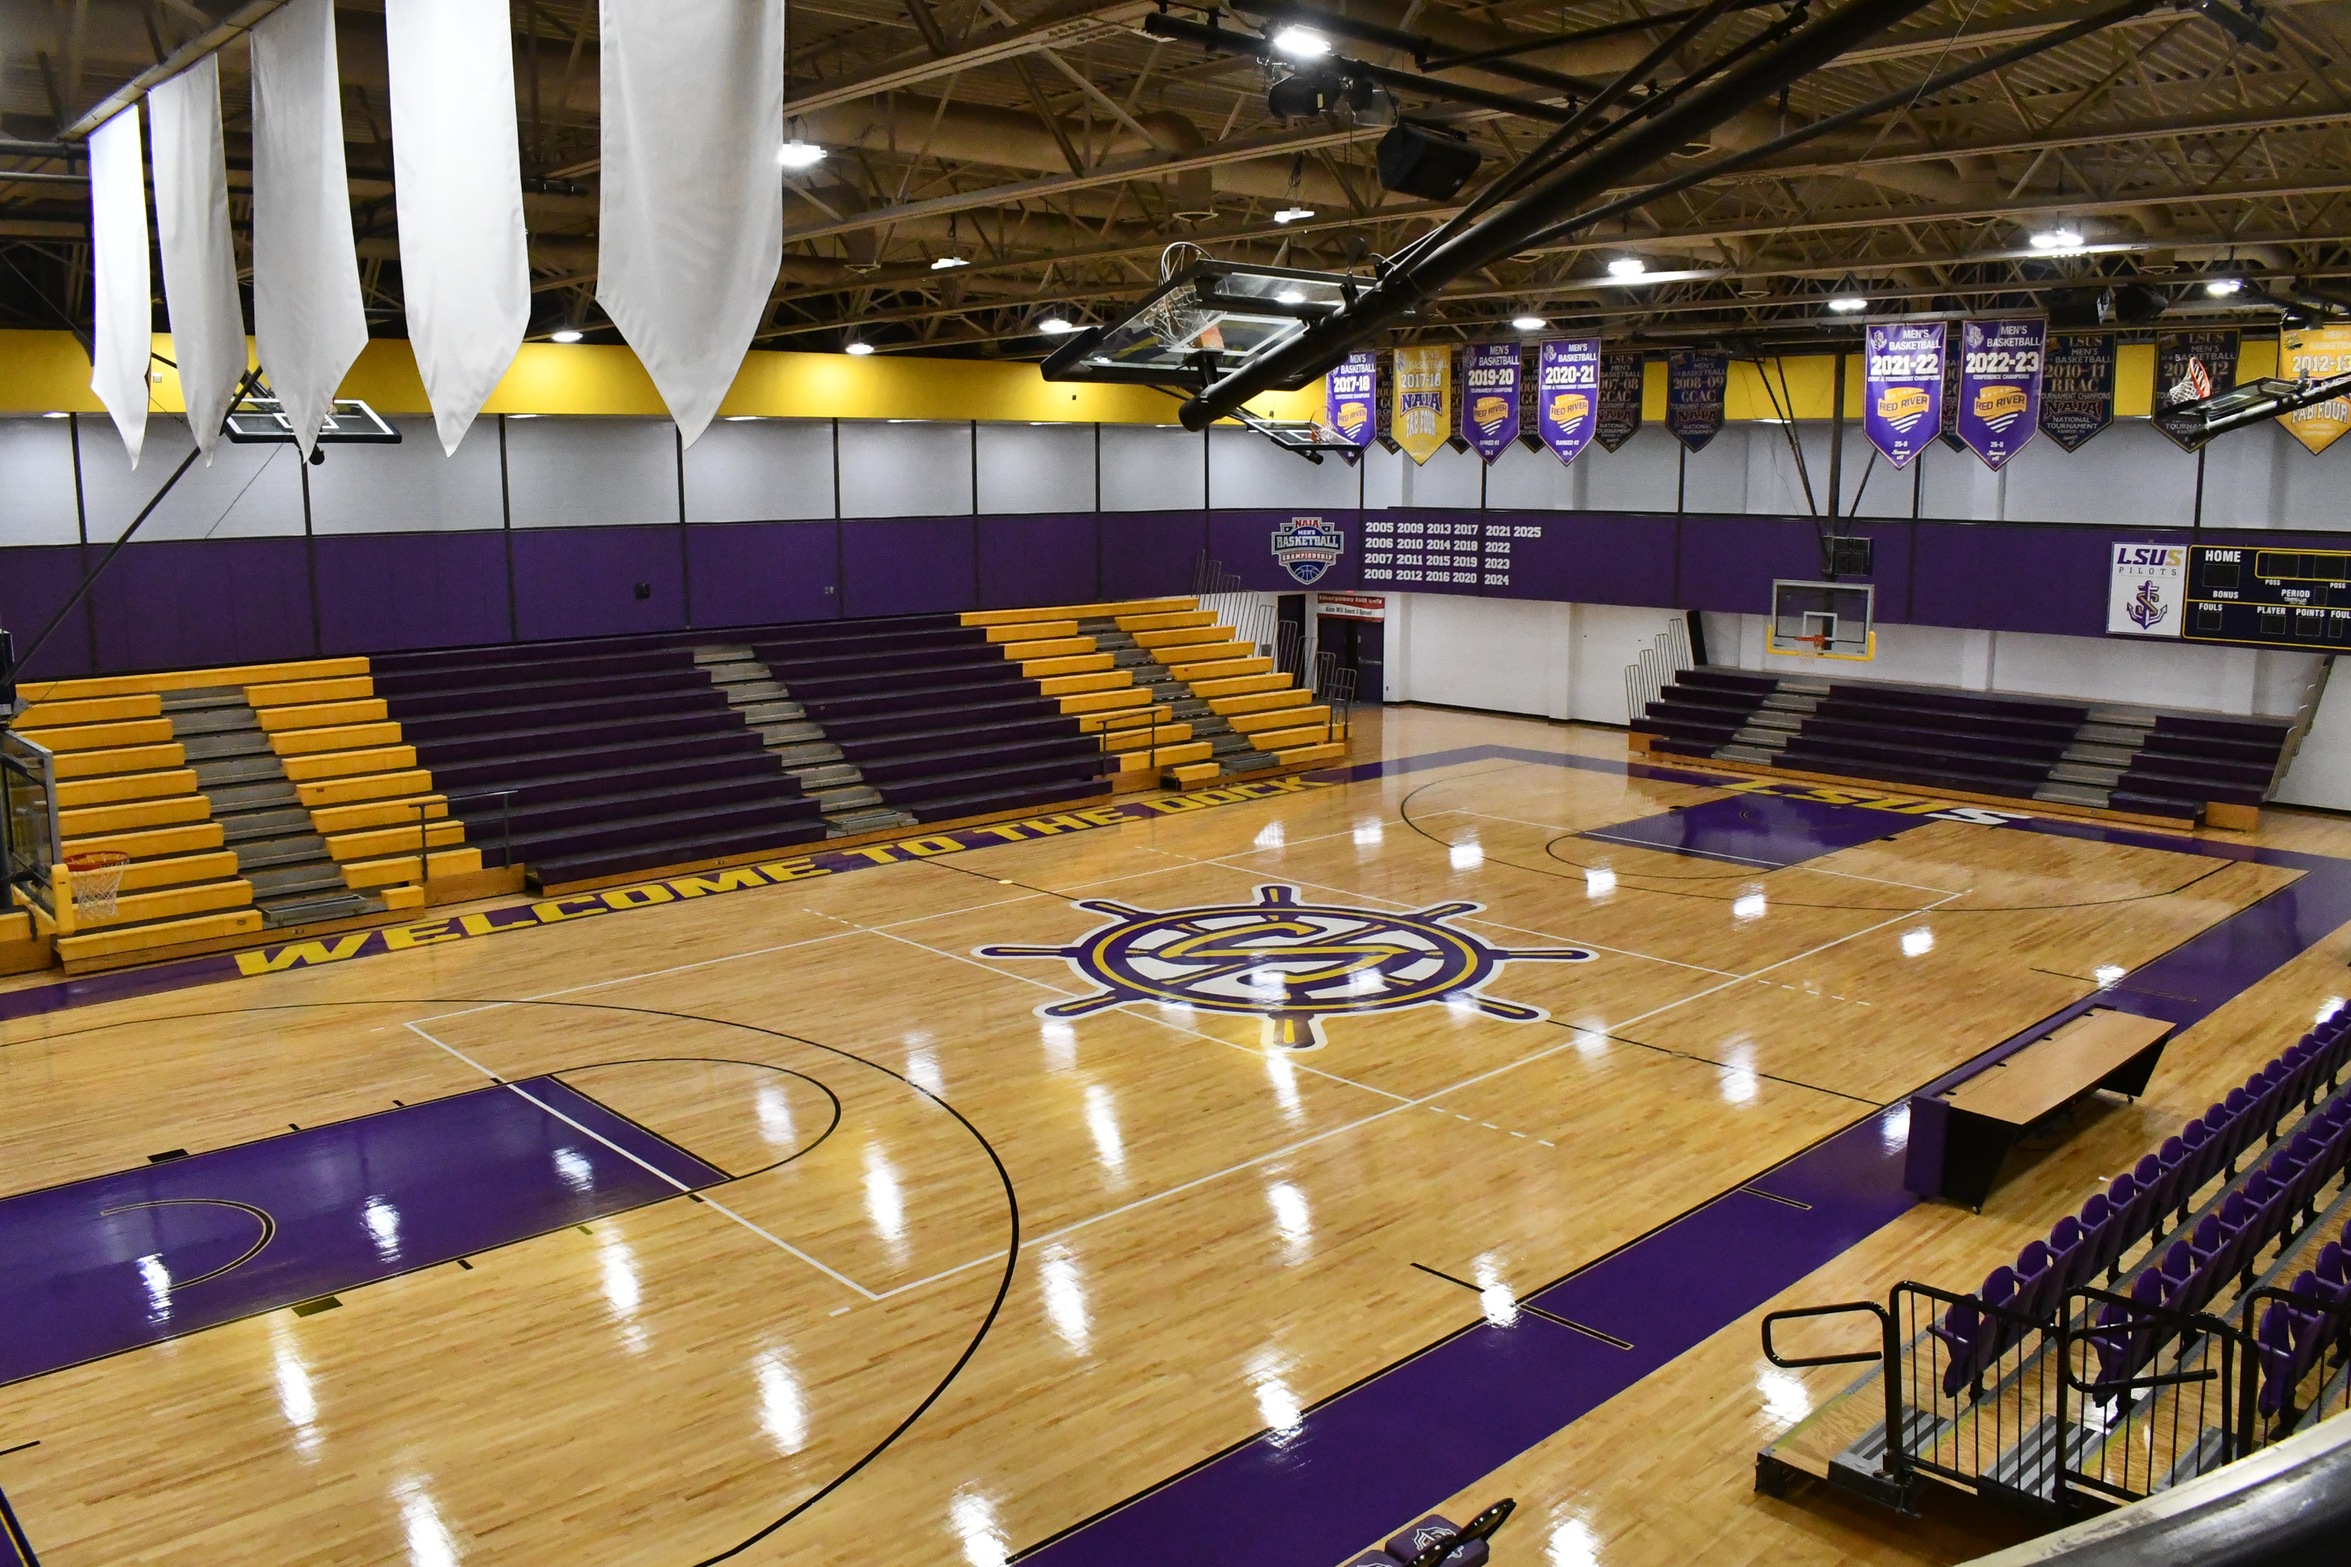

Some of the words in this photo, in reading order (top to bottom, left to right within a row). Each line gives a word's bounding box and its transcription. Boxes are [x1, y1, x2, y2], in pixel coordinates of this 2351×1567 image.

[1902, 329, 1930, 338] MEN'S
[2000, 326, 2028, 336] MEN'S
[1986, 337, 2041, 348] BASKETBALL
[2070, 336, 2102, 347] LSUS
[2189, 333, 2224, 344] LSUS
[1490, 345, 1509, 355] MEN'S
[1568, 344, 1588, 352] MEN'S
[1889, 340, 1941, 350] BASKETBALL
[2190, 345, 2220, 353] MEN'S
[1558, 352, 1597, 362] BASKETBALL
[2072, 348, 2098, 356] MEN'S
[2174, 352, 2236, 362] BASKETBALL
[1350, 354, 1366, 363] MEN'S
[1479, 355, 1519, 366] BASKETBALL
[1965, 351, 2039, 374] 2022-23
[2055, 356, 2112, 364] BASKETBALL
[1341, 362, 1376, 374] BASKETBALL
[1870, 354, 1938, 376] 2021-22
[2044, 364, 2106, 378] 2010-11
[1401, 373, 1441, 388] 2017-18
[1468, 368, 1514, 386] 2019-20
[1545, 365, 1594, 384] 2020-21
[1334, 376, 1370, 392] 2017-18
[1674, 376, 1724, 390] 2008-09
[2052, 378, 2098, 392] RRAC
[2078, 392, 2111, 400] CHAMPIONS
[1401, 392, 1442, 415] NAIA
[1879, 402, 1898, 412] RED
[1900, 396, 1928, 408] RIVER
[1976, 400, 1993, 411] RED
[1996, 396, 2025, 408] RIVER
[2045, 401, 2101, 418] NAIA
[1338, 412, 1350, 422] RED
[1350, 409, 1366, 420] RIVER
[1474, 408, 1486, 418] RED
[1488, 404, 1507, 415] RIVER
[1551, 407, 1566, 416] RED
[1567, 404, 1588, 414] RIVER
[2317, 401, 2348, 424] FOUR
[1296, 520, 1319, 528] NAIA
[1366, 522, 1394, 533] 2005
[1397, 522, 1424, 534] 2009
[1427, 522, 1451, 534] 2013
[1454, 524, 1478, 536] 2017
[1486, 526, 1510, 537] 2021
[1514, 526, 1541, 538] 2025
[1276, 536, 1338, 549] BASKETBALL
[1365, 538, 1394, 549] 2006
[1396, 538, 1424, 550] 2010
[1426, 539, 1450, 550] 2014
[1454, 540, 1478, 552] 2018
[1485, 542, 1510, 553] 2022
[1282, 552, 1333, 560] CHAMPIONSHIP
[1364, 554, 1393, 564] 2007
[1396, 554, 1422, 566] 2011
[1426, 555, 1450, 566] 2015
[1453, 556, 1477, 568] 2019
[1484, 558, 1510, 570] 2023
[2118, 548, 2184, 566] LSUS
[2205, 550, 2242, 563] HOME
[2118, 566, 2177, 576] PILOTS
[1364, 569, 1392, 580] 2008
[1396, 570, 1422, 581] 2012
[1426, 570, 1450, 582] 2016
[1452, 572, 1476, 584] 2020
[1484, 574, 1509, 586] 2024
[2212, 590, 2239, 599] BONUS
[2281, 588, 2310, 598] PERIOD
[2199, 602, 2222, 612] FOULS
[2257, 606, 2286, 615] PLAYER
[2296, 608, 2325, 618] POINTS
[1714, 779, 2034, 825] LSUS
[235, 859, 831, 976] WELCOME
[842, 836, 967, 865] TO
[986, 806, 1142, 842] THE
[1139, 774, 1335, 815] DOCK
